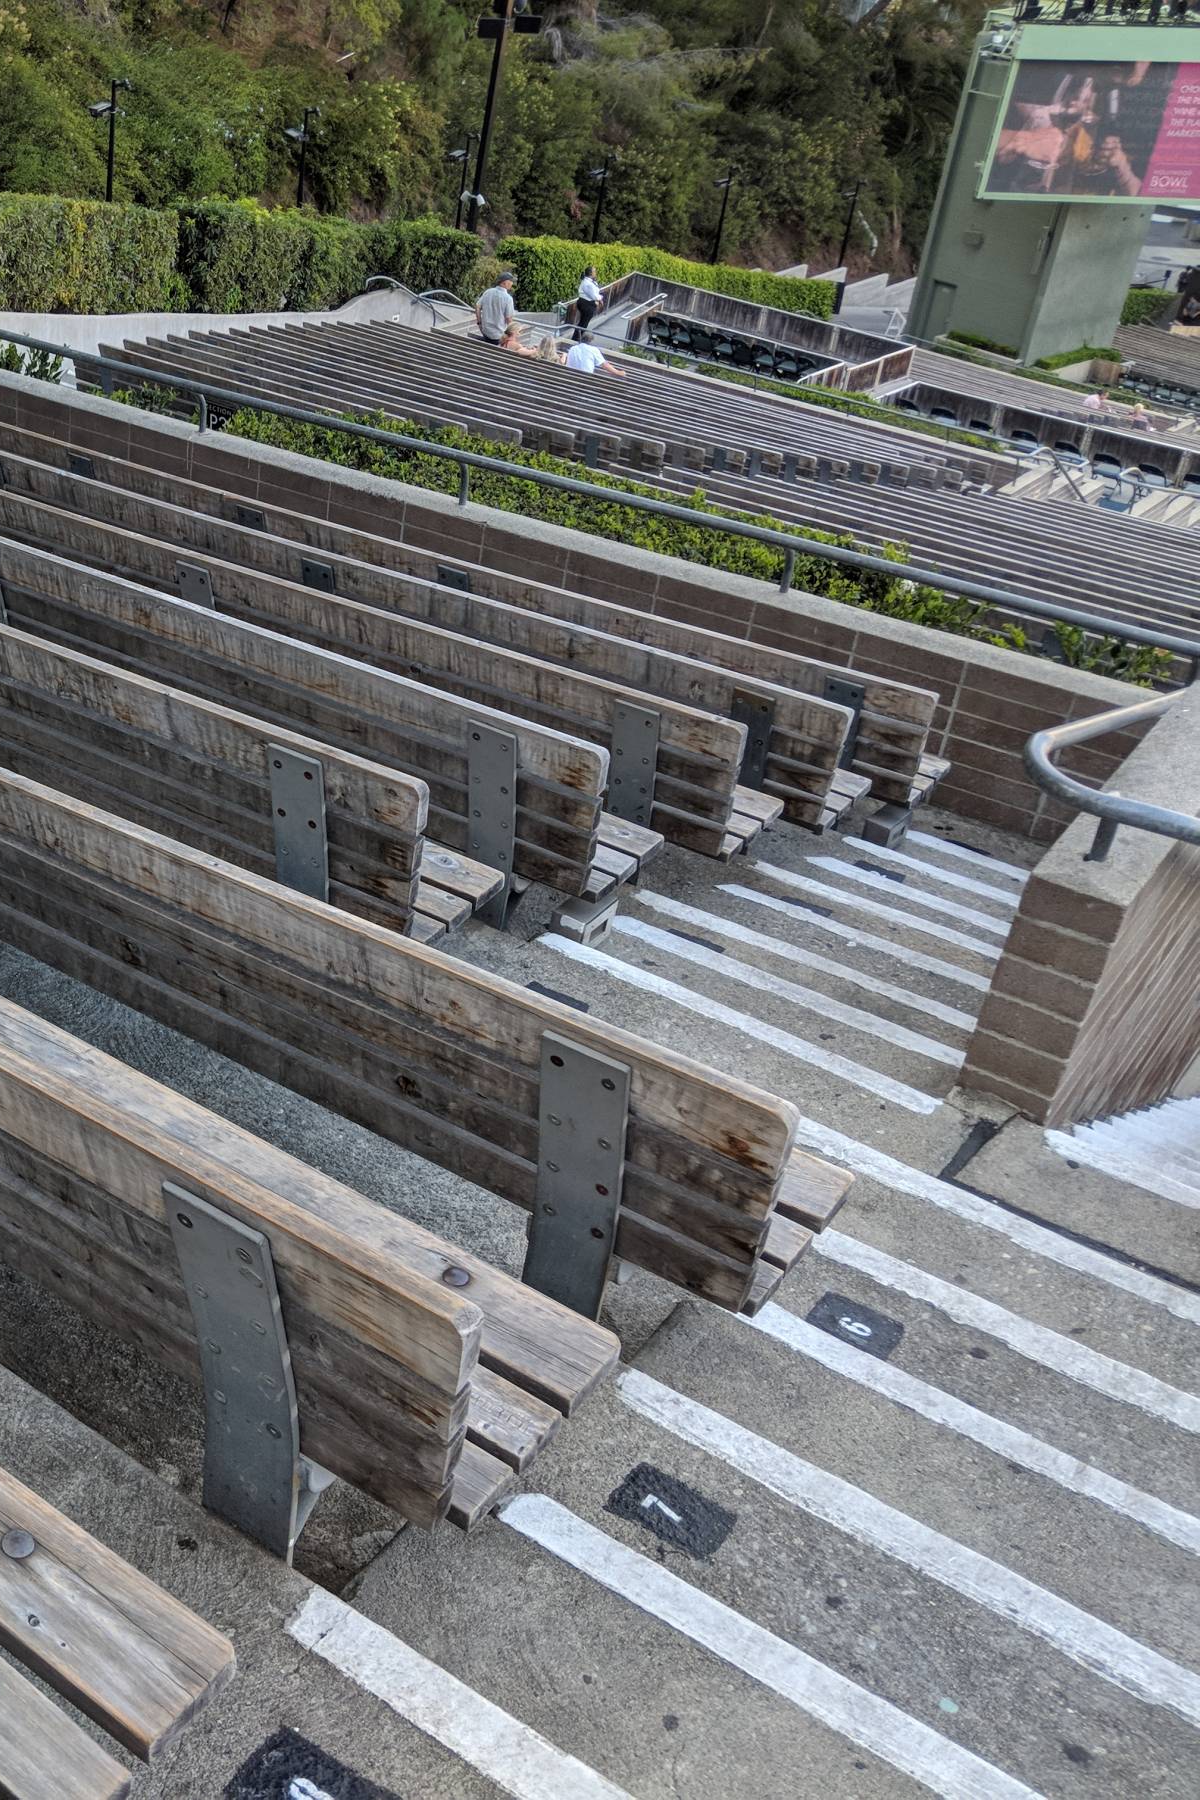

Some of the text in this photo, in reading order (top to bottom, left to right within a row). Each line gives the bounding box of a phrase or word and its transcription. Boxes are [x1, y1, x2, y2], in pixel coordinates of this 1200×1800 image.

[1151, 176, 1188, 187] BOWL
[209, 404, 232, 415] ECTION
[839, 1316, 873, 1337] 6
